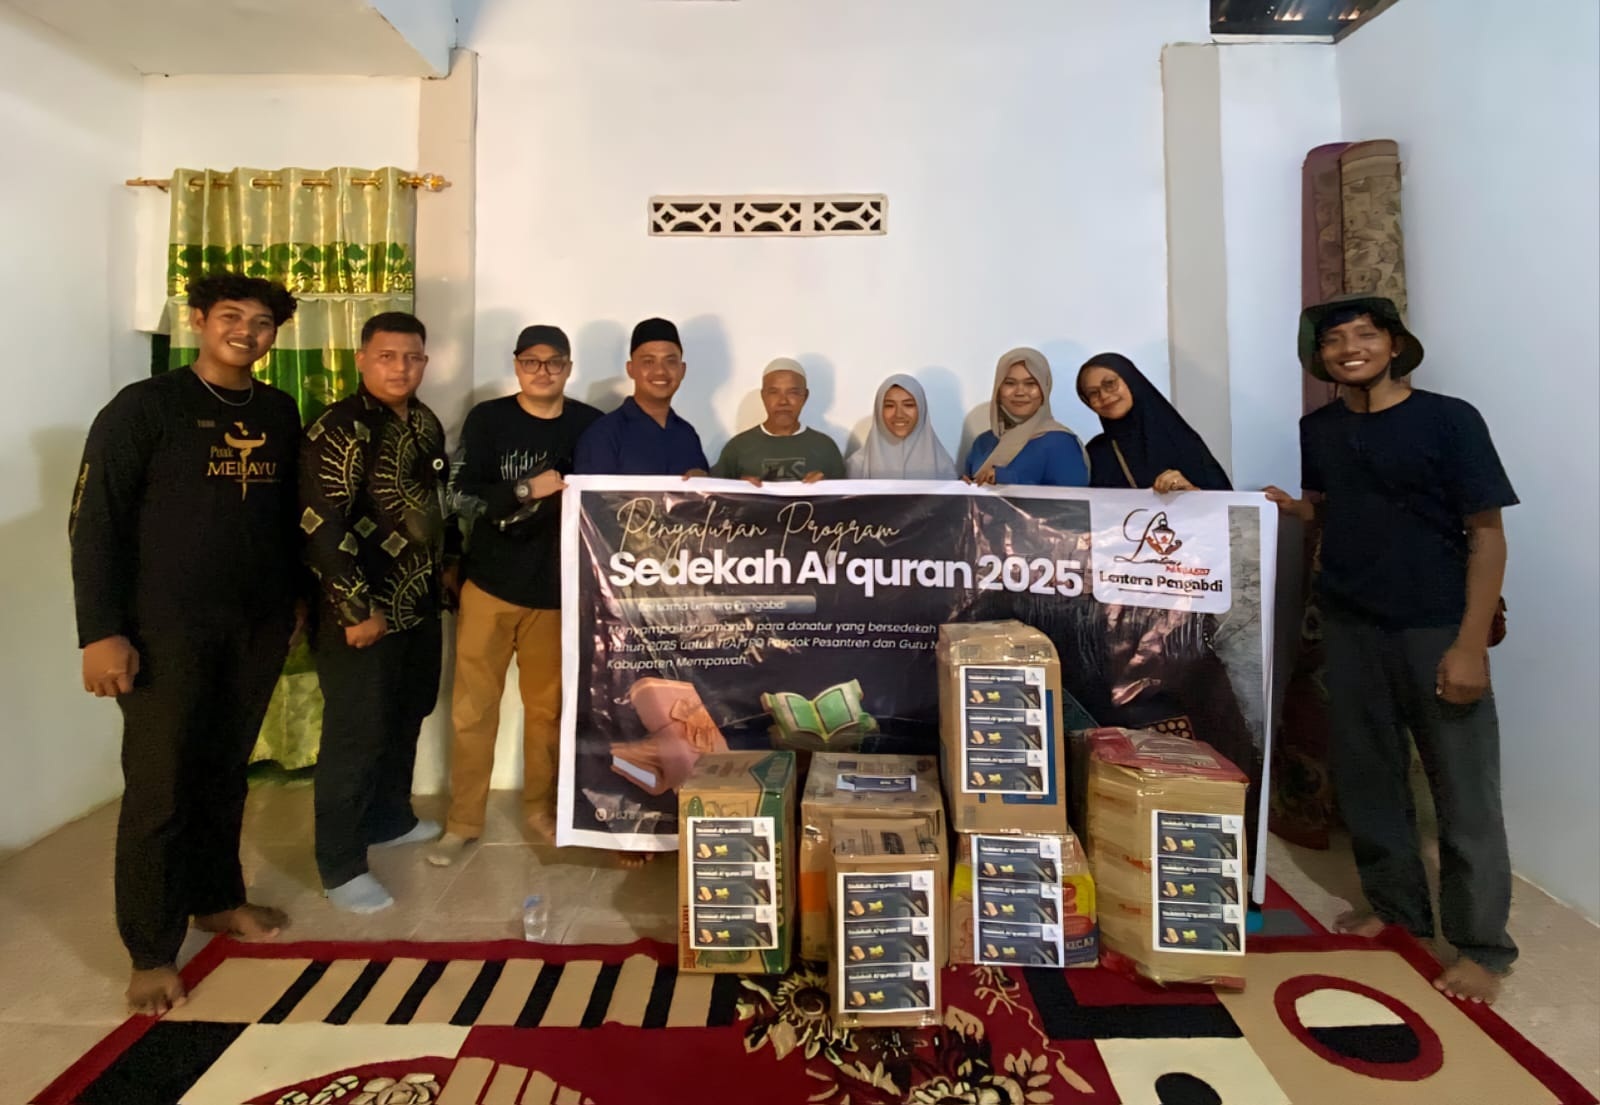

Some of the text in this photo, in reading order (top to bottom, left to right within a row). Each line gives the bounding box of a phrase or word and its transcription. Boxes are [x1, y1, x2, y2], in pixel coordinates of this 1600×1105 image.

[207, 461, 277, 476] MELAYU
[616, 497, 900, 566] Penyaluran Program
[609, 549, 791, 587] Sedekah
[978, 555, 1084, 598] 2025
[1099, 570, 1153, 586] Lentera
[1157, 575, 1224, 593] Pengabdi
[756, 623, 784, 636] para
[787, 621, 833, 631] donatur
[835, 623, 865, 635] yang
[868, 622, 937, 635] bersedekah
[812, 639, 868, 649] Pesantren
[872, 639, 896, 649] dan
[899, 640, 928, 651] Guru
[607, 658, 673, 672] Kabupaten
